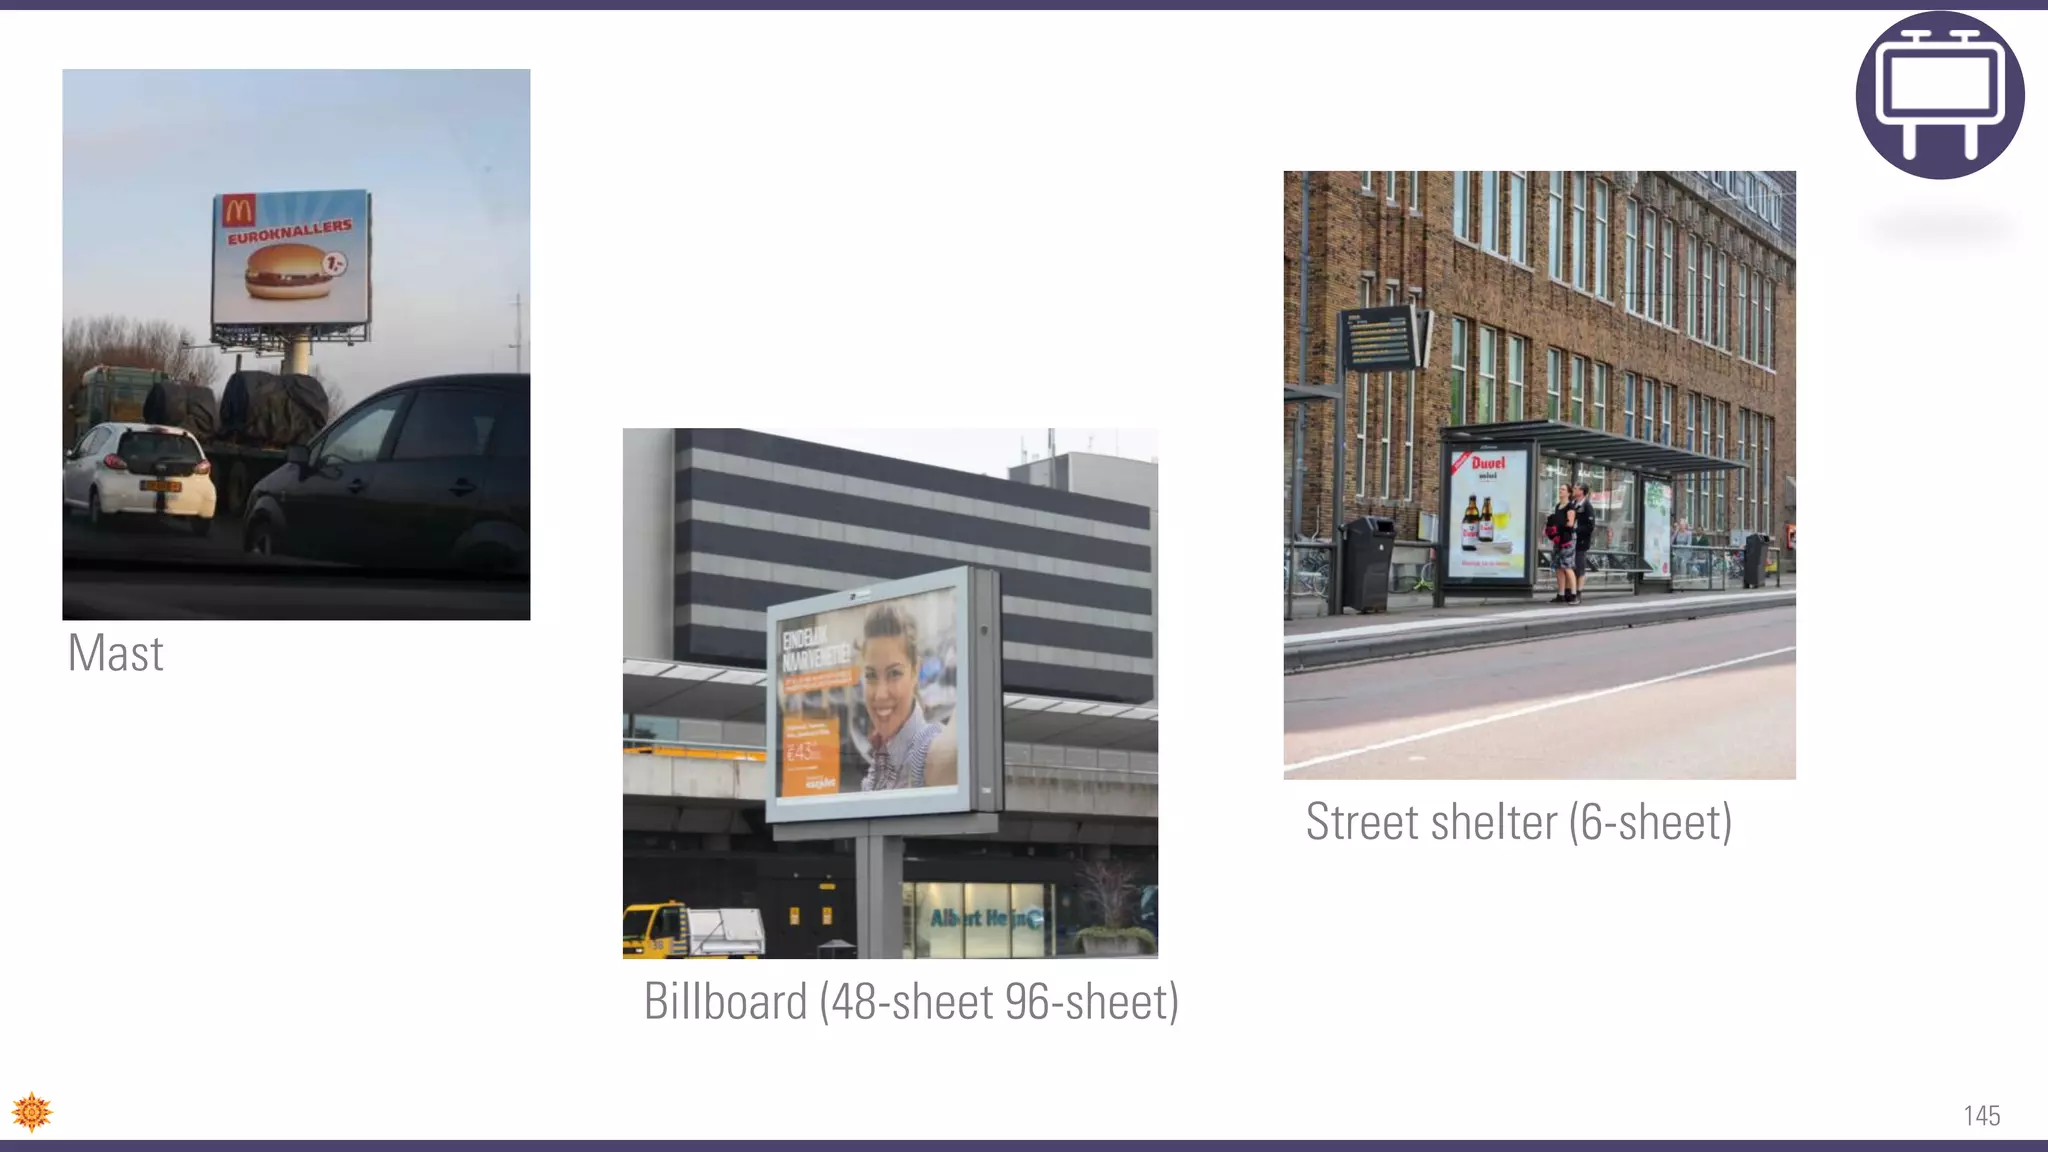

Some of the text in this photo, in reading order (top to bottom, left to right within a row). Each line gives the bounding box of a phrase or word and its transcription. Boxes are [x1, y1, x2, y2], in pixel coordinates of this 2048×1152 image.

[227, 219, 353, 245] EUROKNALLERS
[1472, 456, 1505, 469] Duvel
[930, 908, 982, 928] Albert
